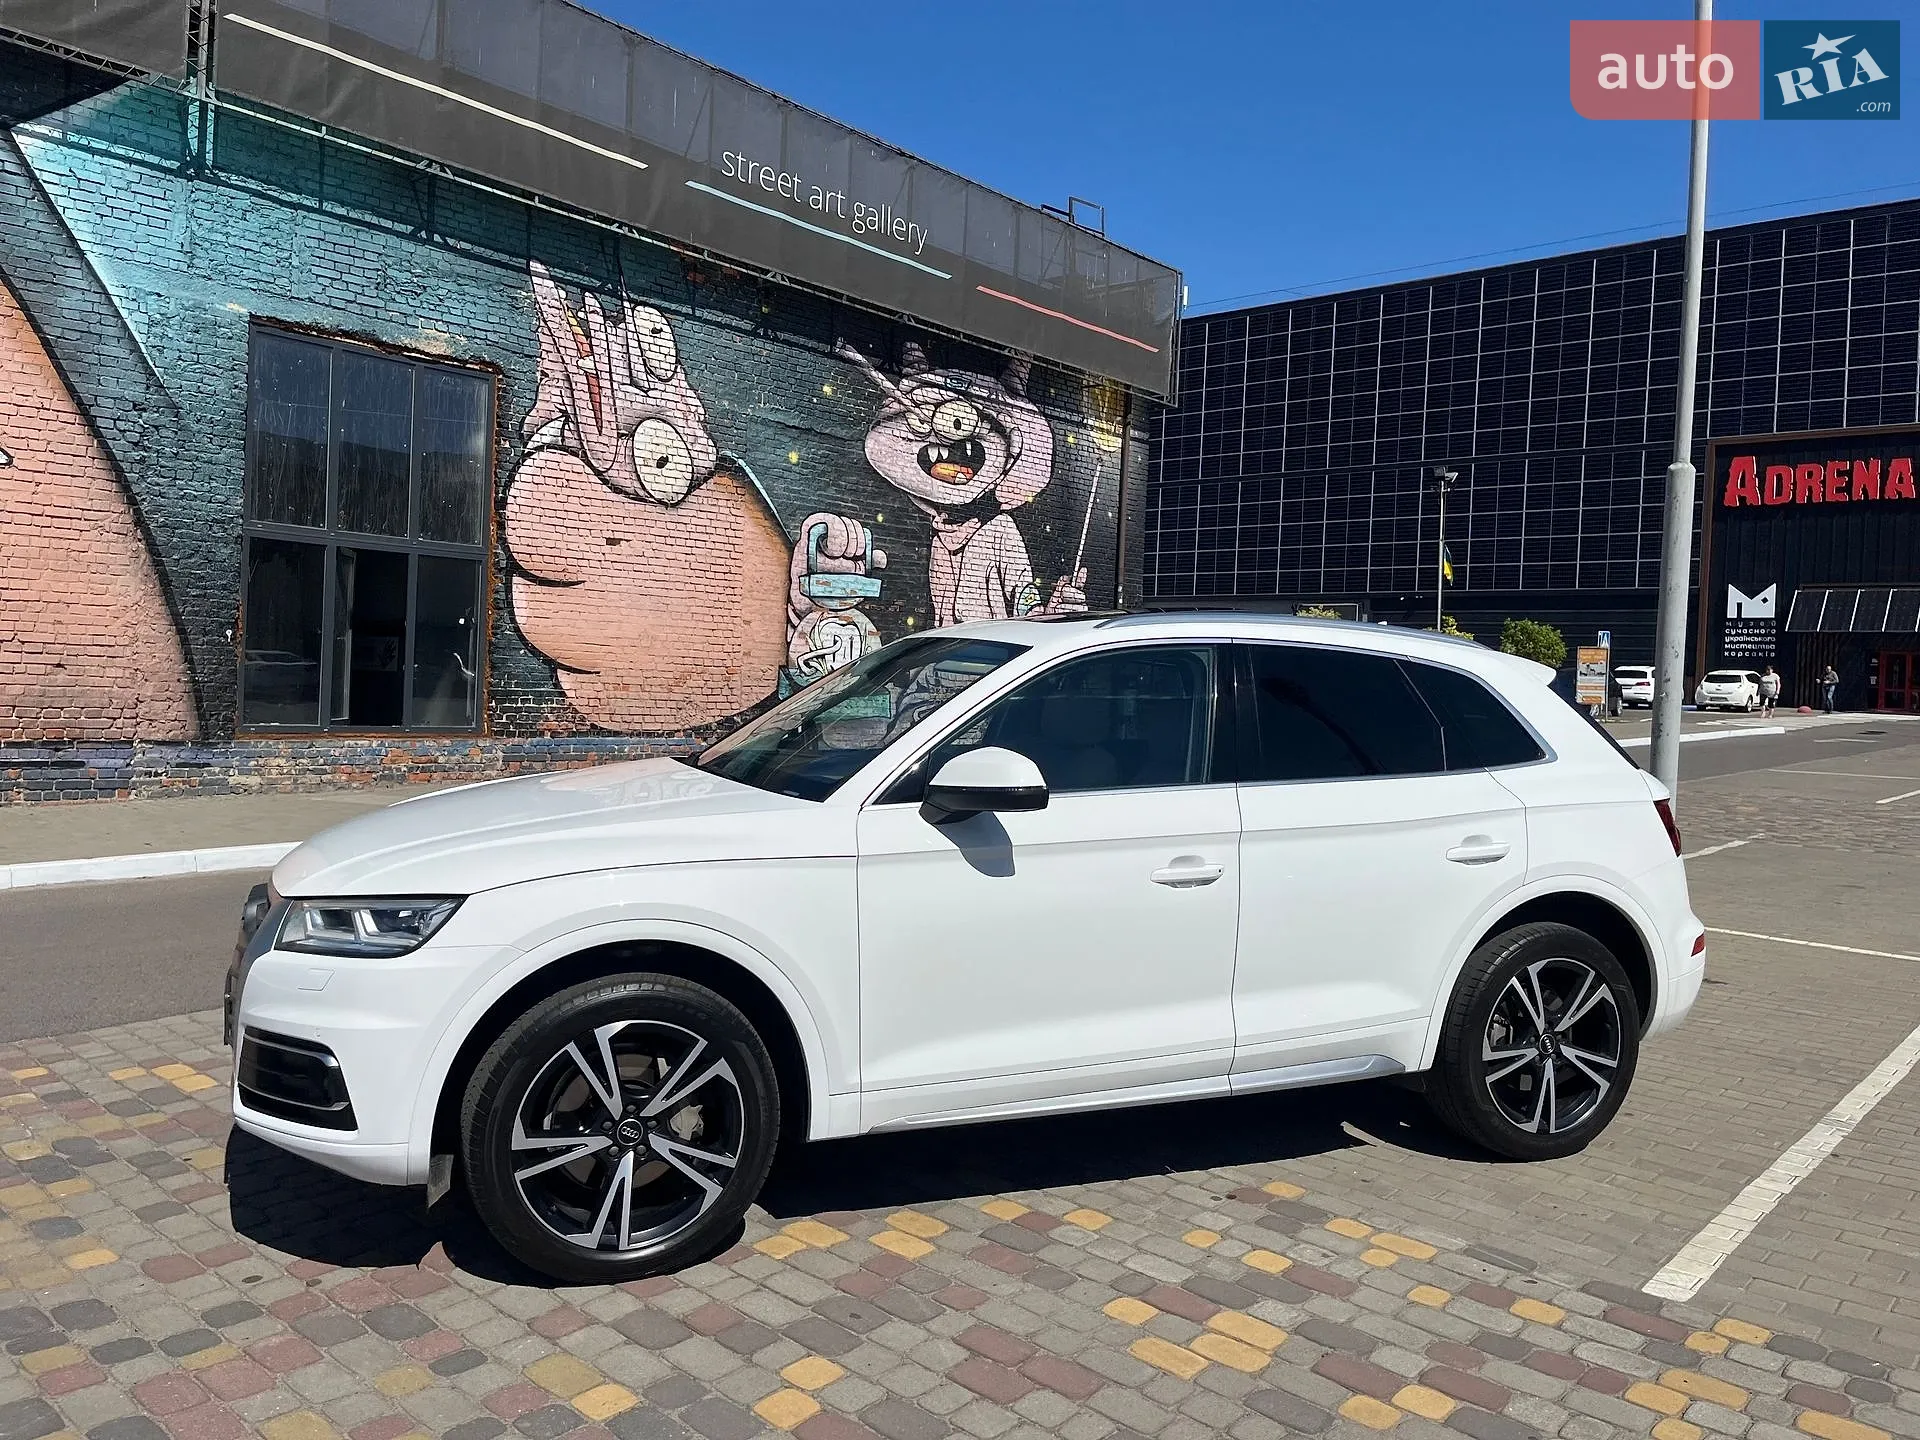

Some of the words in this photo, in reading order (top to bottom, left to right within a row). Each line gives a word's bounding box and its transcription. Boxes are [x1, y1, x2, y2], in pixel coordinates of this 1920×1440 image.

[721, 150, 802, 203] street
[808, 184, 846, 219] art
[851, 201, 928, 256] gallery
[1724, 635, 1776, 643] українського
